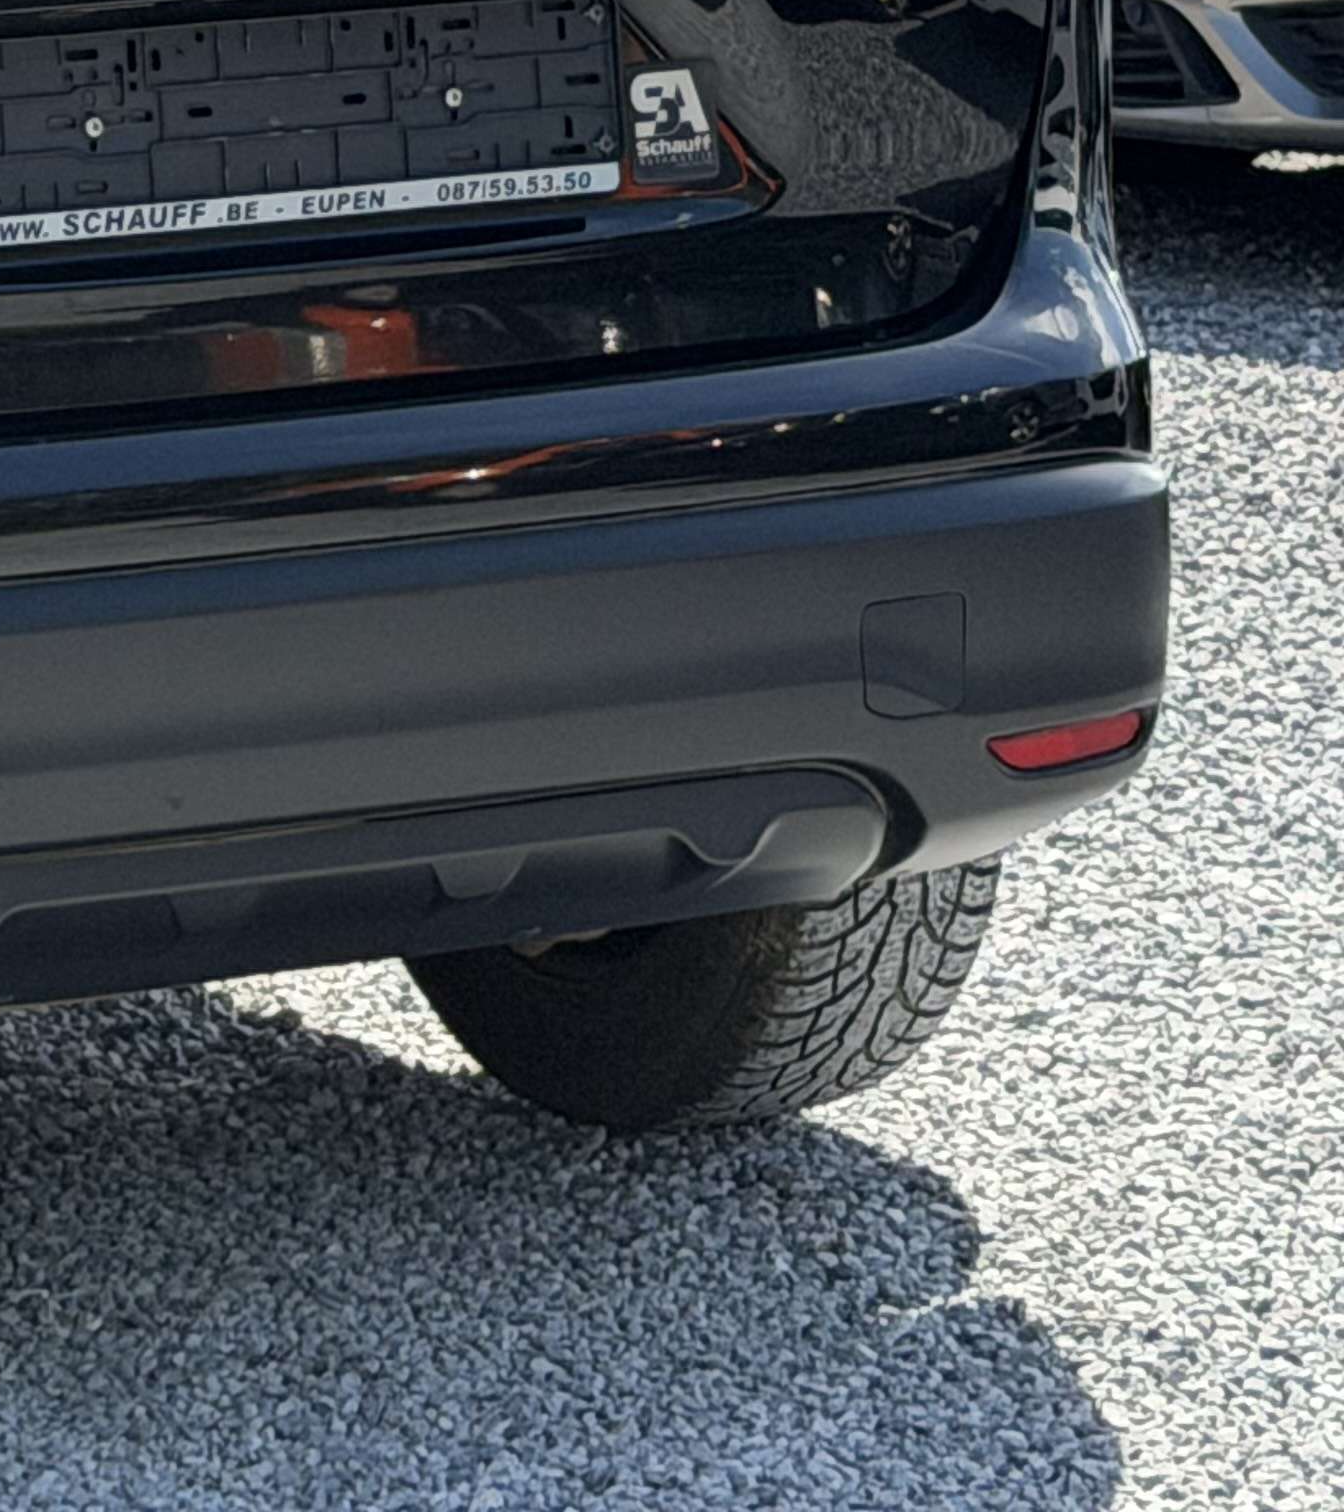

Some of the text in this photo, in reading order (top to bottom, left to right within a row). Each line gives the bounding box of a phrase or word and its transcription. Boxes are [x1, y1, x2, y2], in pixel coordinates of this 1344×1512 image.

[635, 134, 712, 158] Schauff
[62, 202, 207, 236] SCHAUFF
[217, 200, 260, 224] .BE
[301, 189, 386, 215] EUPEN
[436, 171, 593, 202] 087/59.53.50
